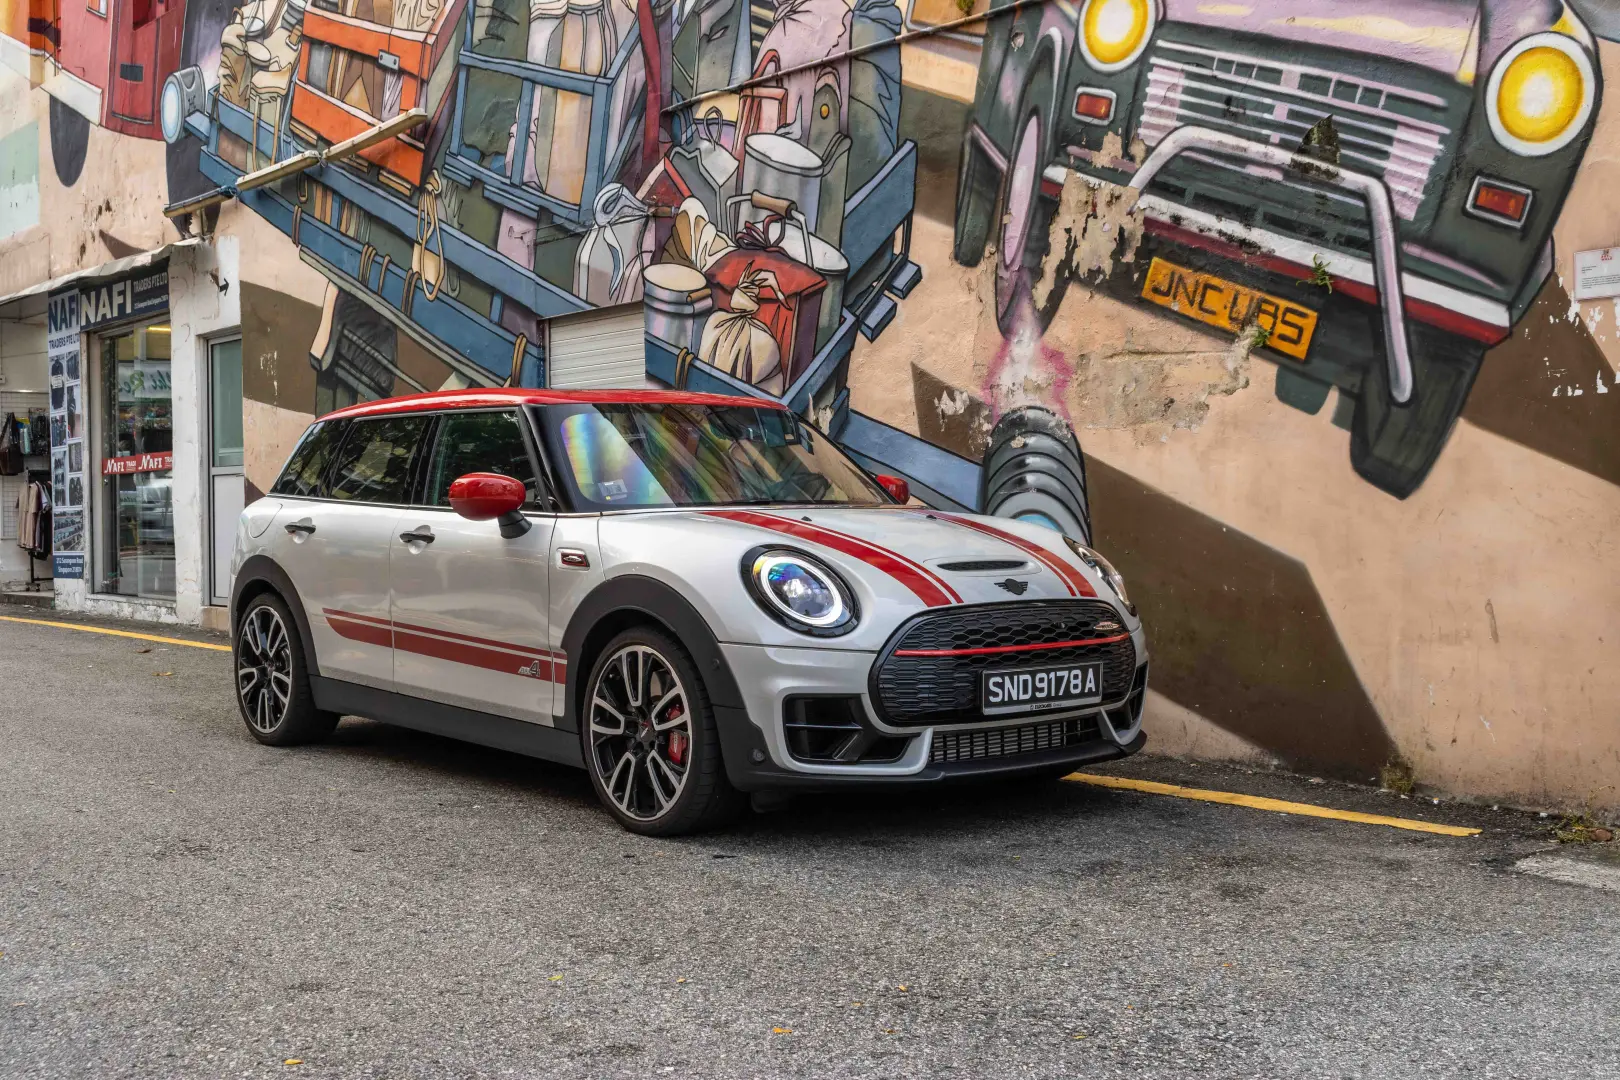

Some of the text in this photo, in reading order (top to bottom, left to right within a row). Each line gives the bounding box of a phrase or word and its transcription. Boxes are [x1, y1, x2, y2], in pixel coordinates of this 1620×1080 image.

[48, 291, 80, 334] NAFI
[80, 279, 132, 327] NAFI
[133, 276, 152, 293] TRADERS
[152, 273, 160, 288] PTE
[160, 271, 168, 285] LTD
[48, 336, 66, 350] TRADERS
